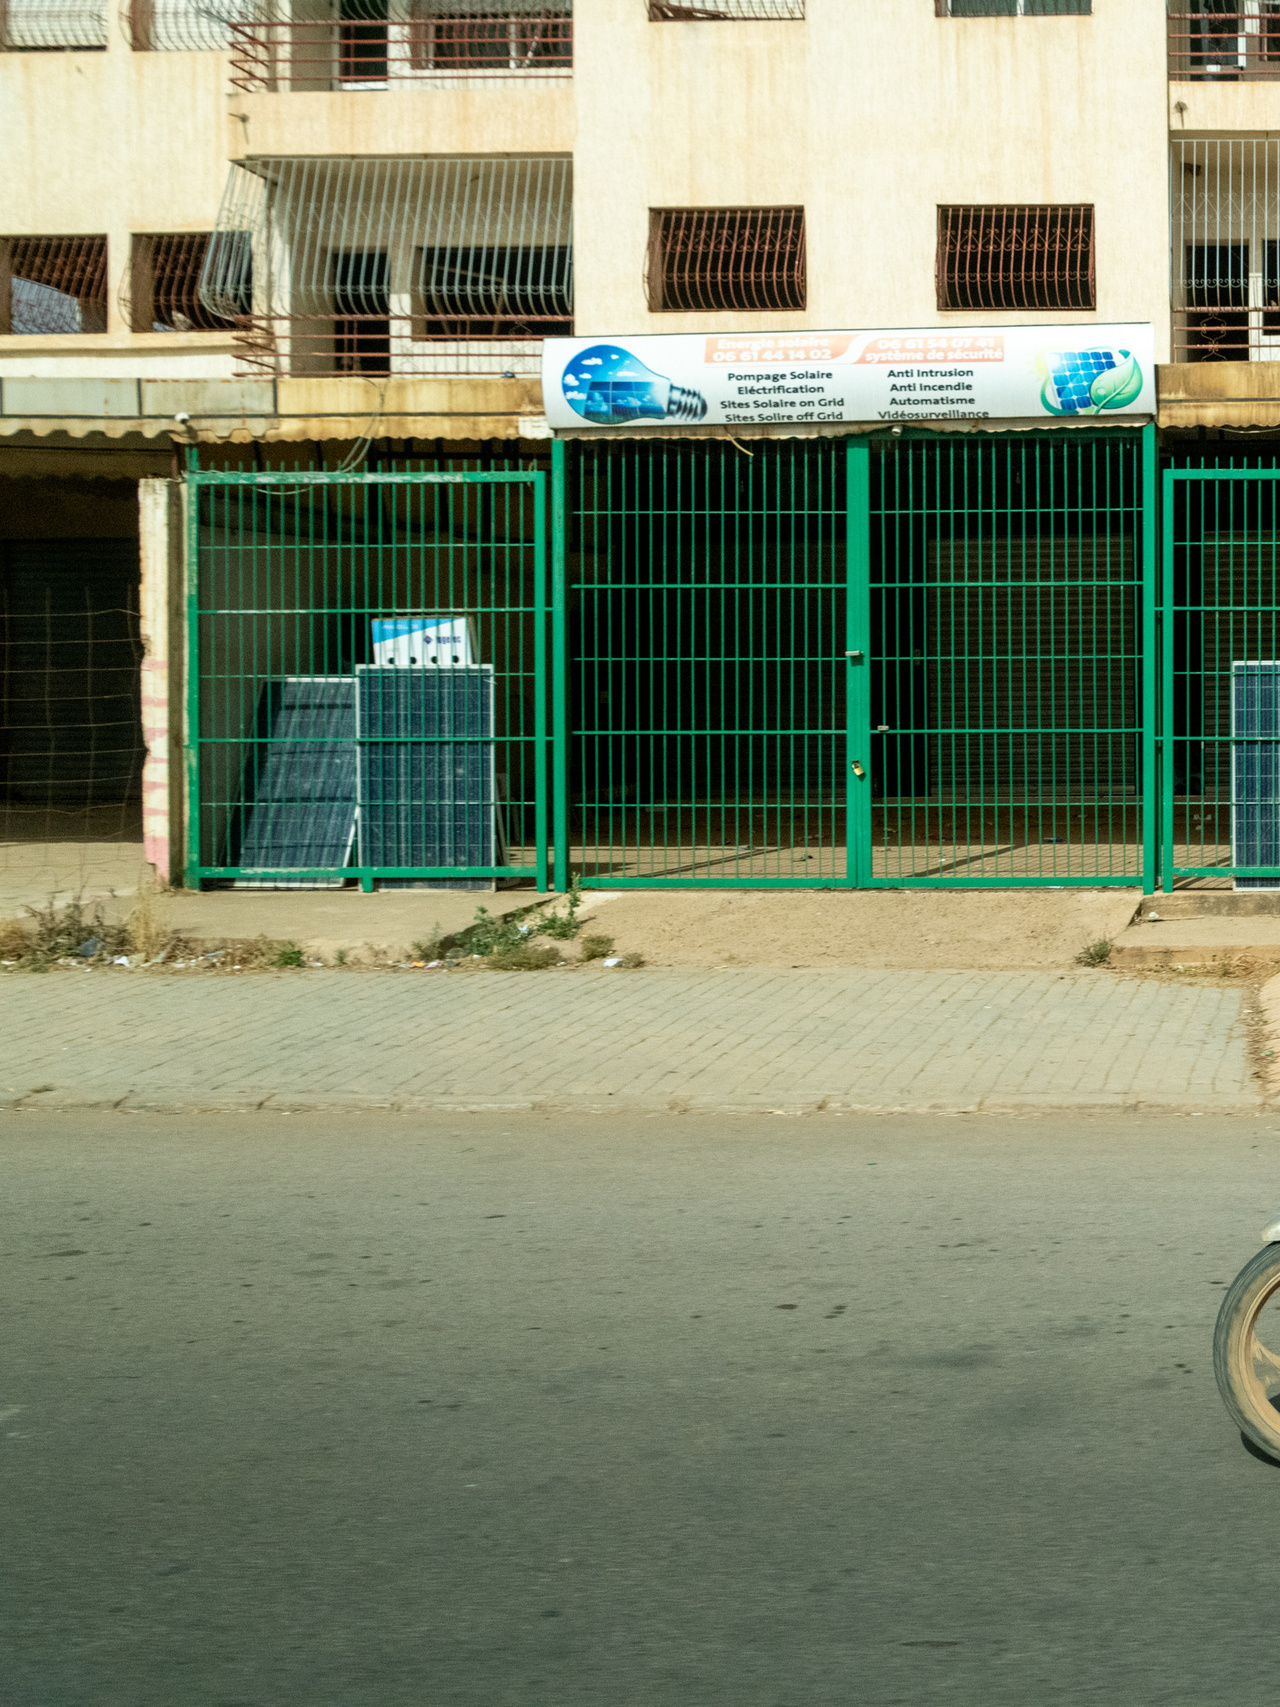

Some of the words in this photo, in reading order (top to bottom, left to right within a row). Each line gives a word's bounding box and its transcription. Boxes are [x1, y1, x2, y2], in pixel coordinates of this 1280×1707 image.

[877, 339, 901, 349] 06
[905, 339, 923, 349] 61
[952, 338, 972, 348] 07
[975, 338, 994, 347] 41
[713, 351, 737, 361] 06
[740, 351, 758, 361] 61
[762, 350, 784, 360] 44
[788, 350, 806, 360] 14
[809, 349, 832, 359] 02
[866, 349, 924, 363] système
[926, 349, 944, 360] de
[947, 347, 1003, 360] sécurité
[728, 372, 787, 383] Pompage
[790, 370, 833, 380] Solaire
[887, 369, 914, 378] Anti
[917, 368, 974, 378] Intrusion
[737, 384, 825, 395] Eléctrification
[890, 383, 917, 392] Anti
[919, 382, 973, 391] Incendie
[720, 400, 750, 409] Sites
[753, 399, 796, 409] Solaire
[818, 398, 845, 407] Grid
[889, 396, 976, 406] Automatisme
[725, 413, 755, 422] Sites
[758, 412, 794, 422] Solire
[796, 412, 815, 421] off
[817, 411, 844, 420] Grid
[878, 409, 990, 419] Vidéosurveillance
